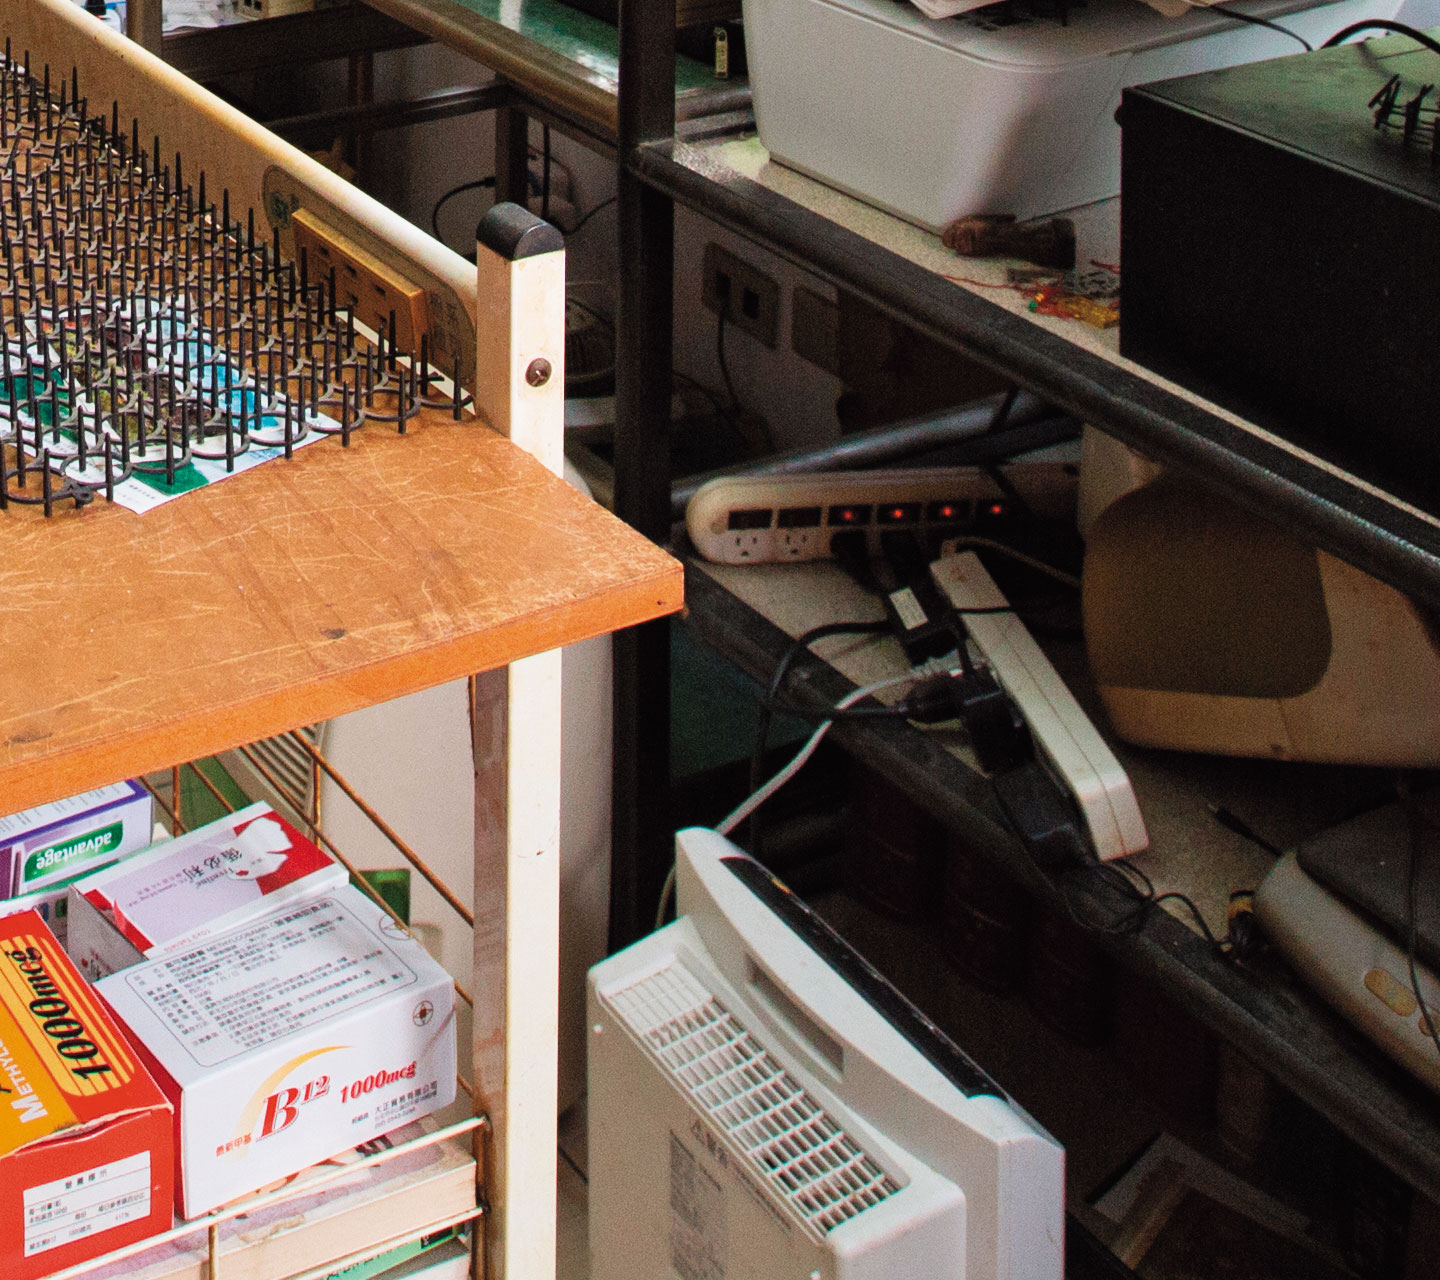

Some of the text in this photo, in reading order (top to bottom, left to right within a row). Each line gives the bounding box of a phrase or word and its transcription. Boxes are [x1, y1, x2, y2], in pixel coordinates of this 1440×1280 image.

[35, 835, 113, 869] advantage
[3, 946, 112, 1081] 1000mcg
[340, 1060, 418, 1104] 1000mcg
